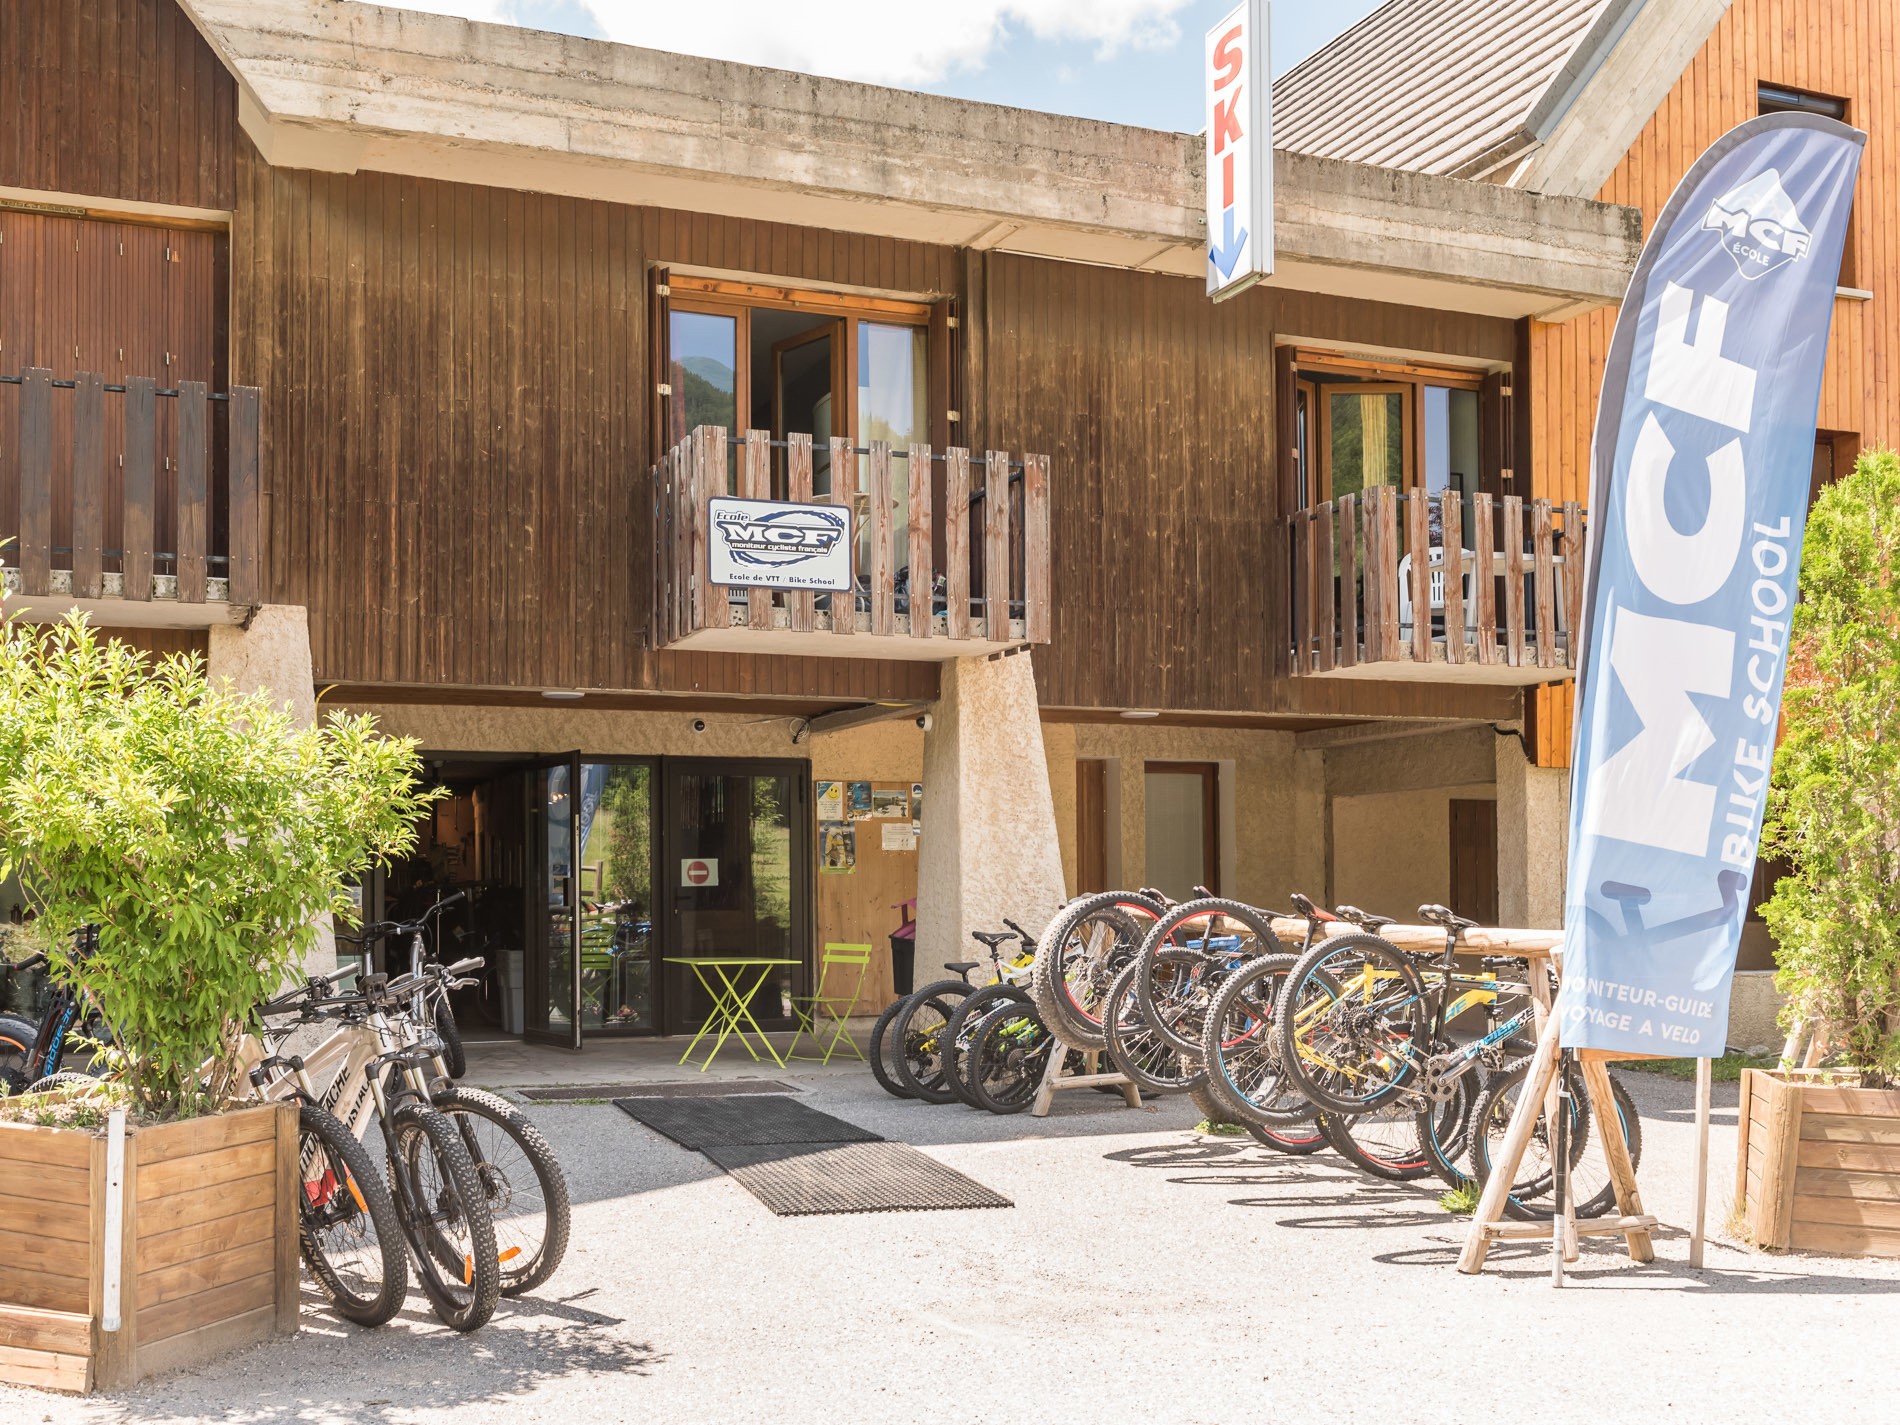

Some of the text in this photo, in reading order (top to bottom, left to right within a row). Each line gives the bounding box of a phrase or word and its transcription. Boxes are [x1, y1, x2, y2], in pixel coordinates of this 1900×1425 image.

[1213, 24, 1244, 209] SKI
[1705, 204, 1809, 256] MCF
[1732, 242, 1770, 266] ÉCOLE
[716, 511, 749, 521] Ecole
[720, 523, 839, 545] MCF
[731, 542, 766, 550] moniteur
[767, 544, 796, 552] cycliste
[729, 573, 750, 581] Ecole
[789, 576, 807, 584] Bike
[1585, 280, 1757, 857] MCF
[1721, 516, 1791, 869] BIKE SCHOOL
[1638, 1020, 1653, 1036] A
[1661, 1023, 1700, 1044] VELO
